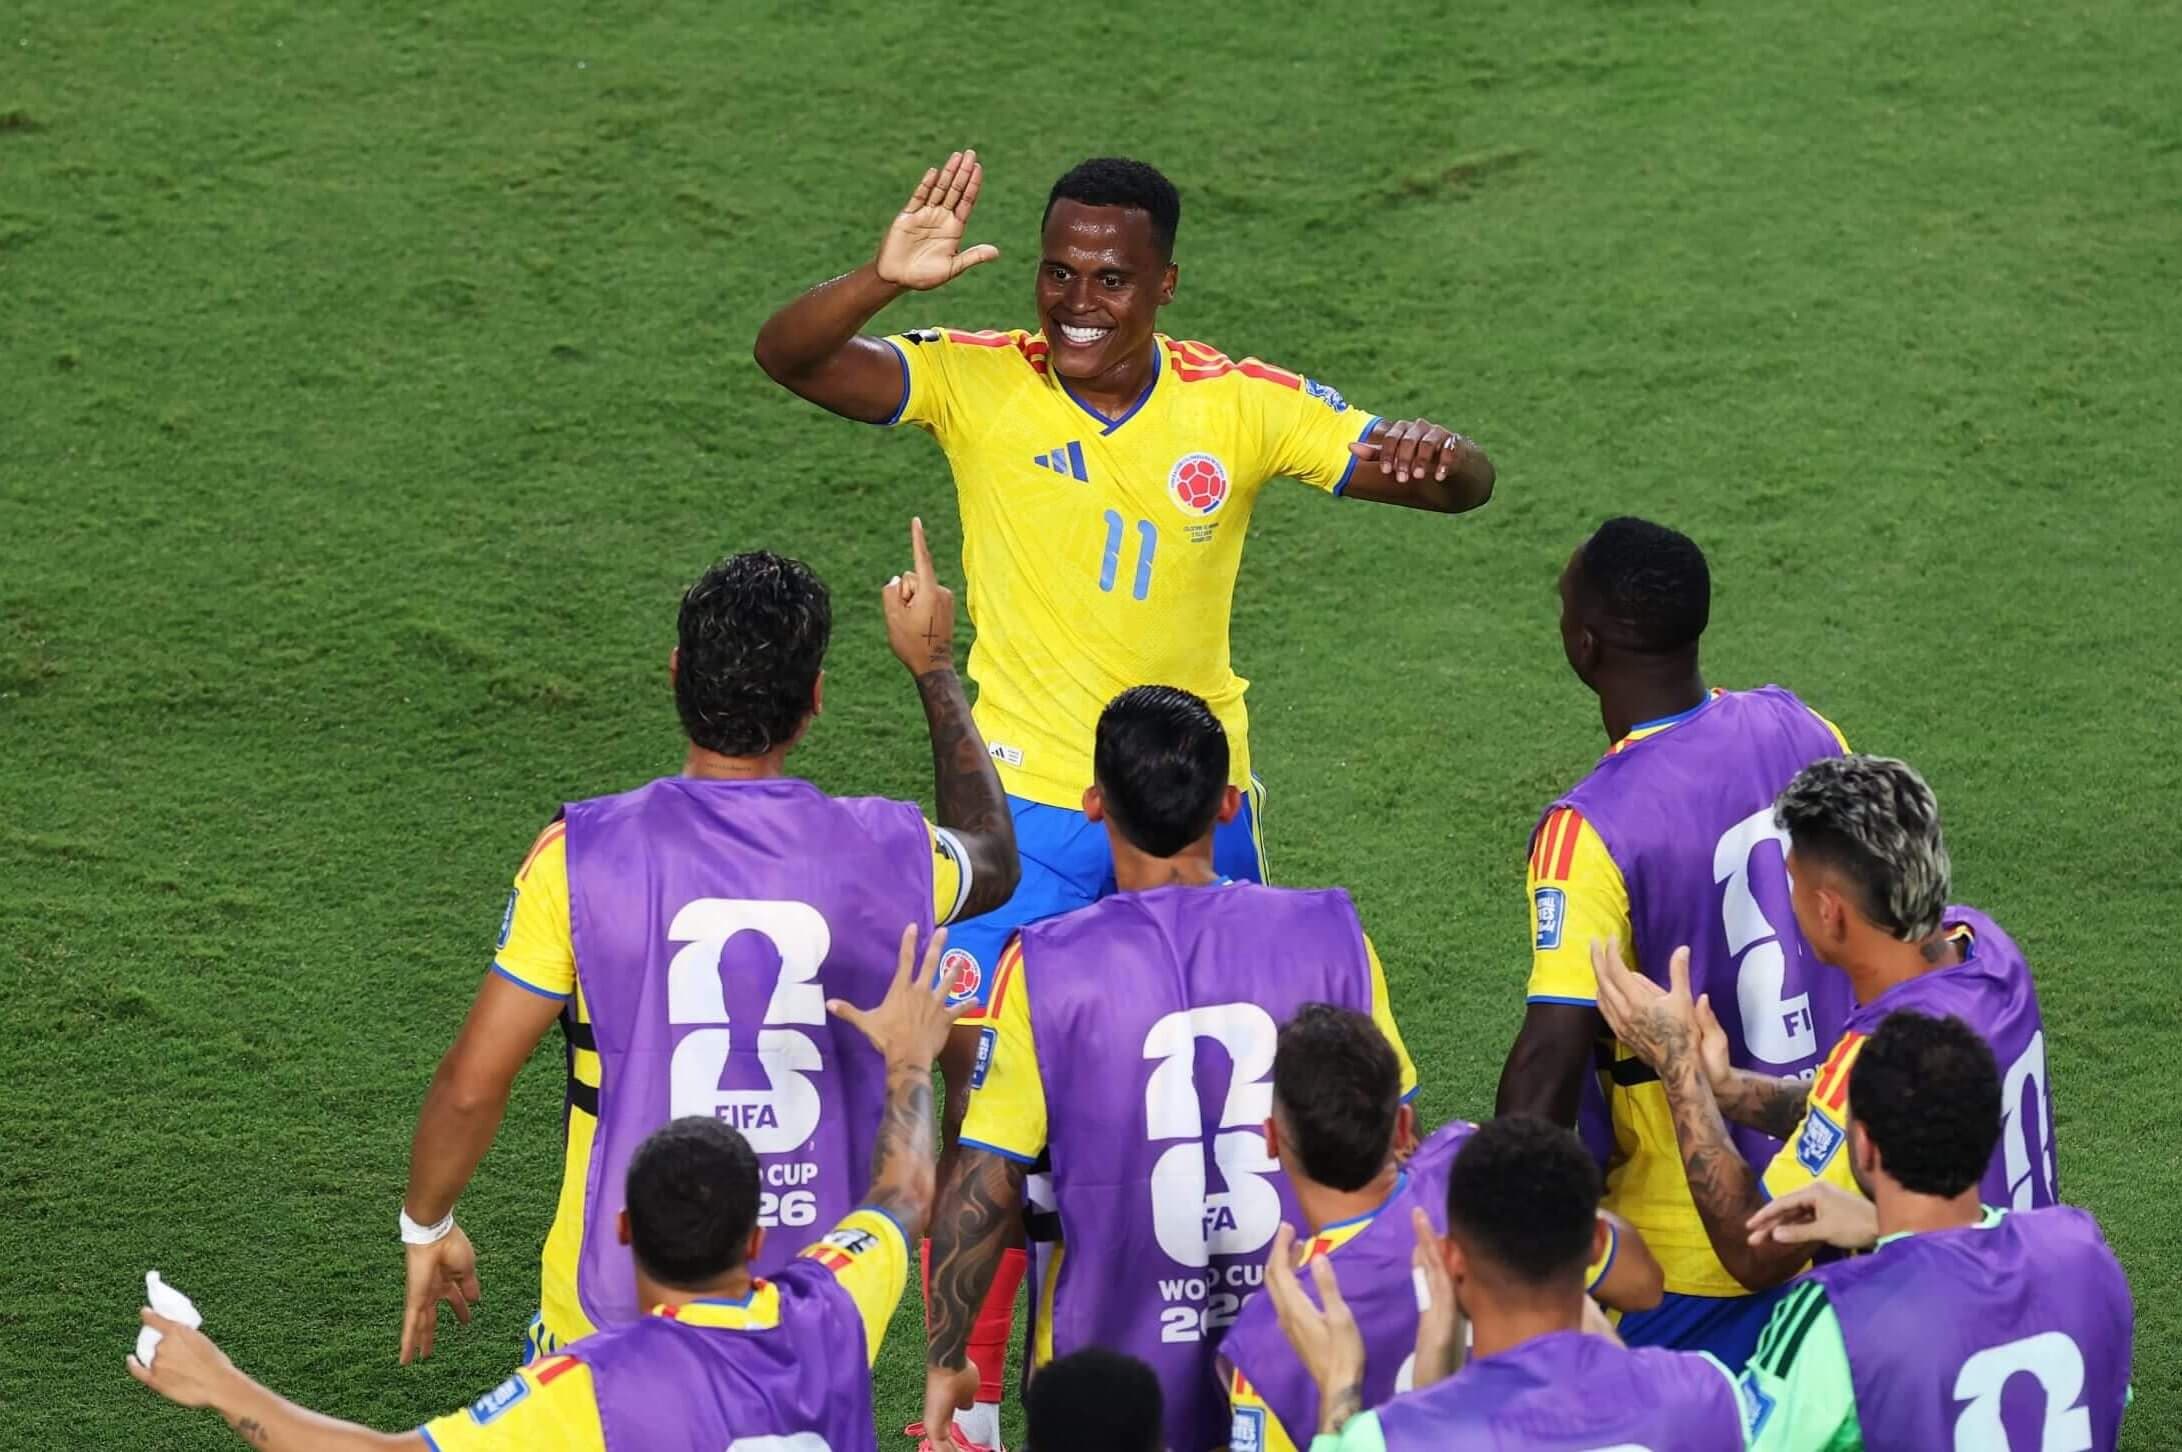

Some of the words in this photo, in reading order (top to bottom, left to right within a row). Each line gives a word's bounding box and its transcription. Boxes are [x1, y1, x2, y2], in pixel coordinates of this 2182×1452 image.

[1099, 509, 1157, 600] 11
[1781, 1007, 1812, 1038] FI
[714, 1104, 779, 1129] FIFA
[767, 1163, 819, 1186] CUP
[757, 1190, 818, 1227] 26
[1201, 1206, 1238, 1242] FA
[1158, 1265, 1220, 1301] WOD
[1225, 1264, 1264, 1287] CU
[1160, 1292, 1257, 1343] 22
